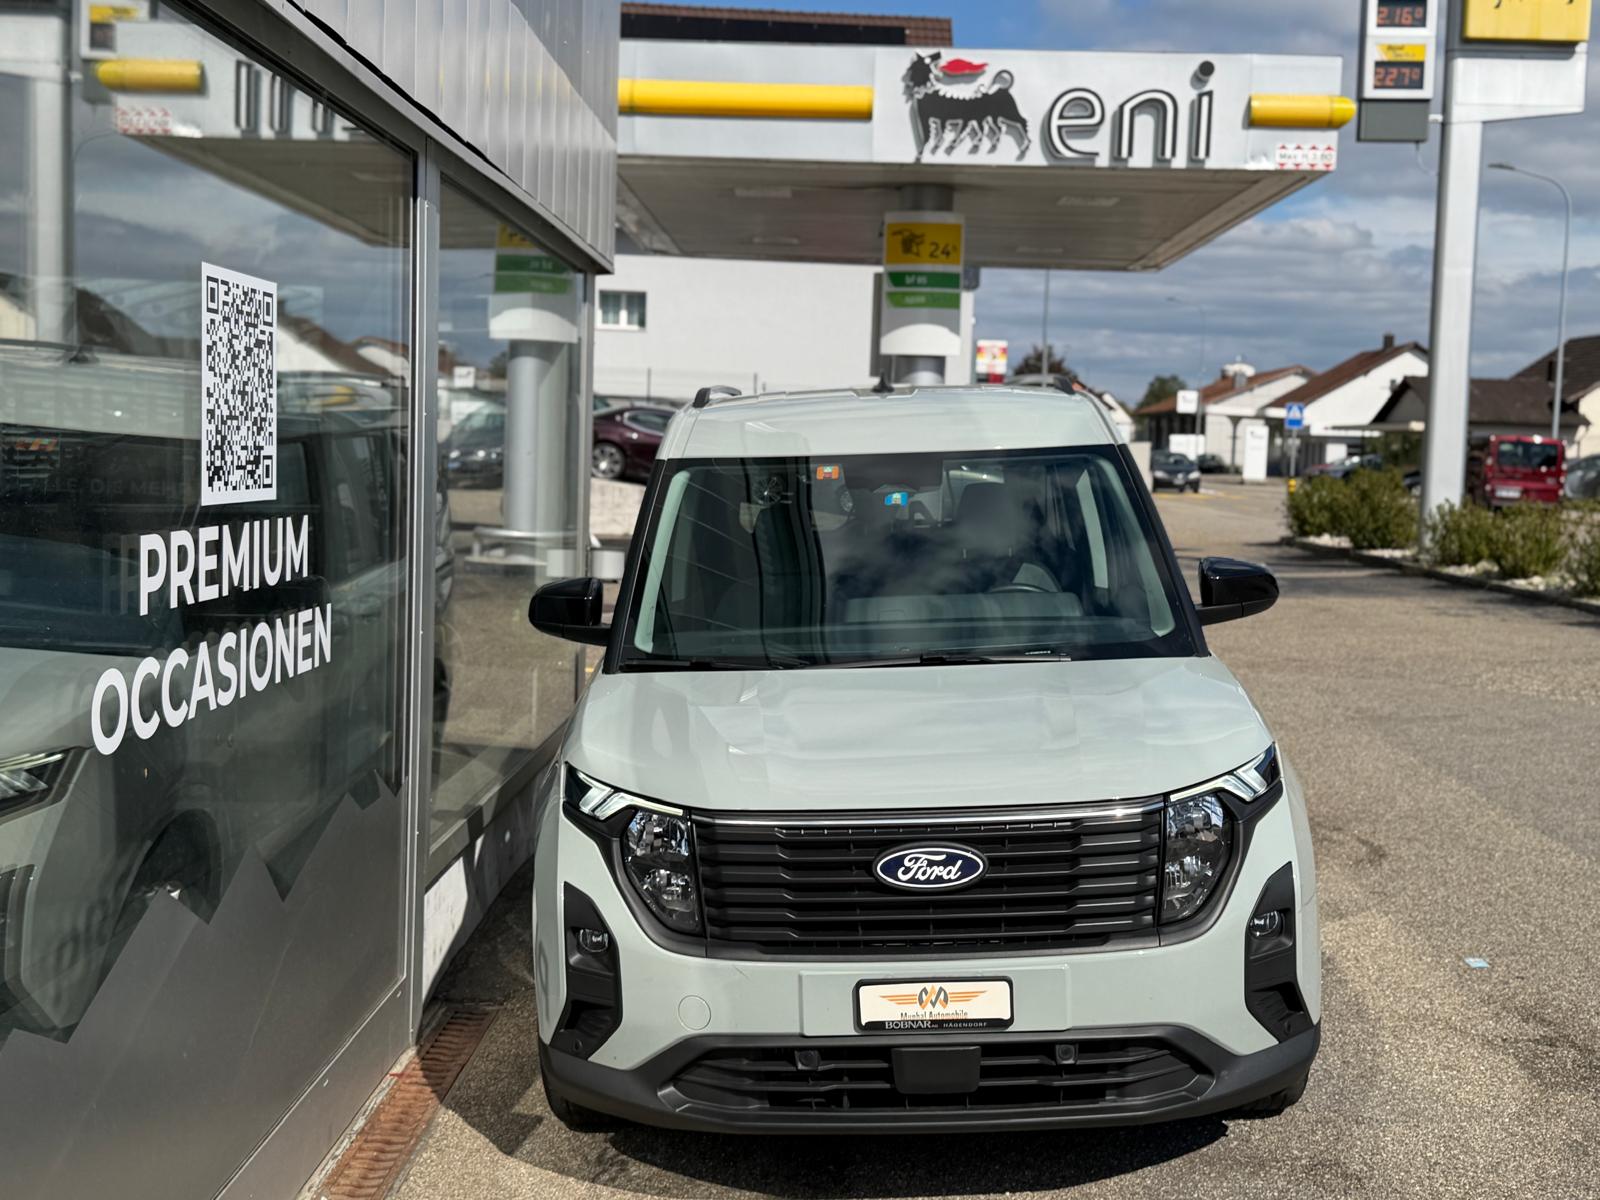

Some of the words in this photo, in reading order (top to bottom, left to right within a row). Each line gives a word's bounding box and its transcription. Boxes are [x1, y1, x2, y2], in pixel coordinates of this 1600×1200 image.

[1047, 60, 1216, 160] eni
[138, 514, 309, 616] PREMIUM
[91, 603, 332, 756] OCCASIONEN
[896, 853, 963, 882] Ford
